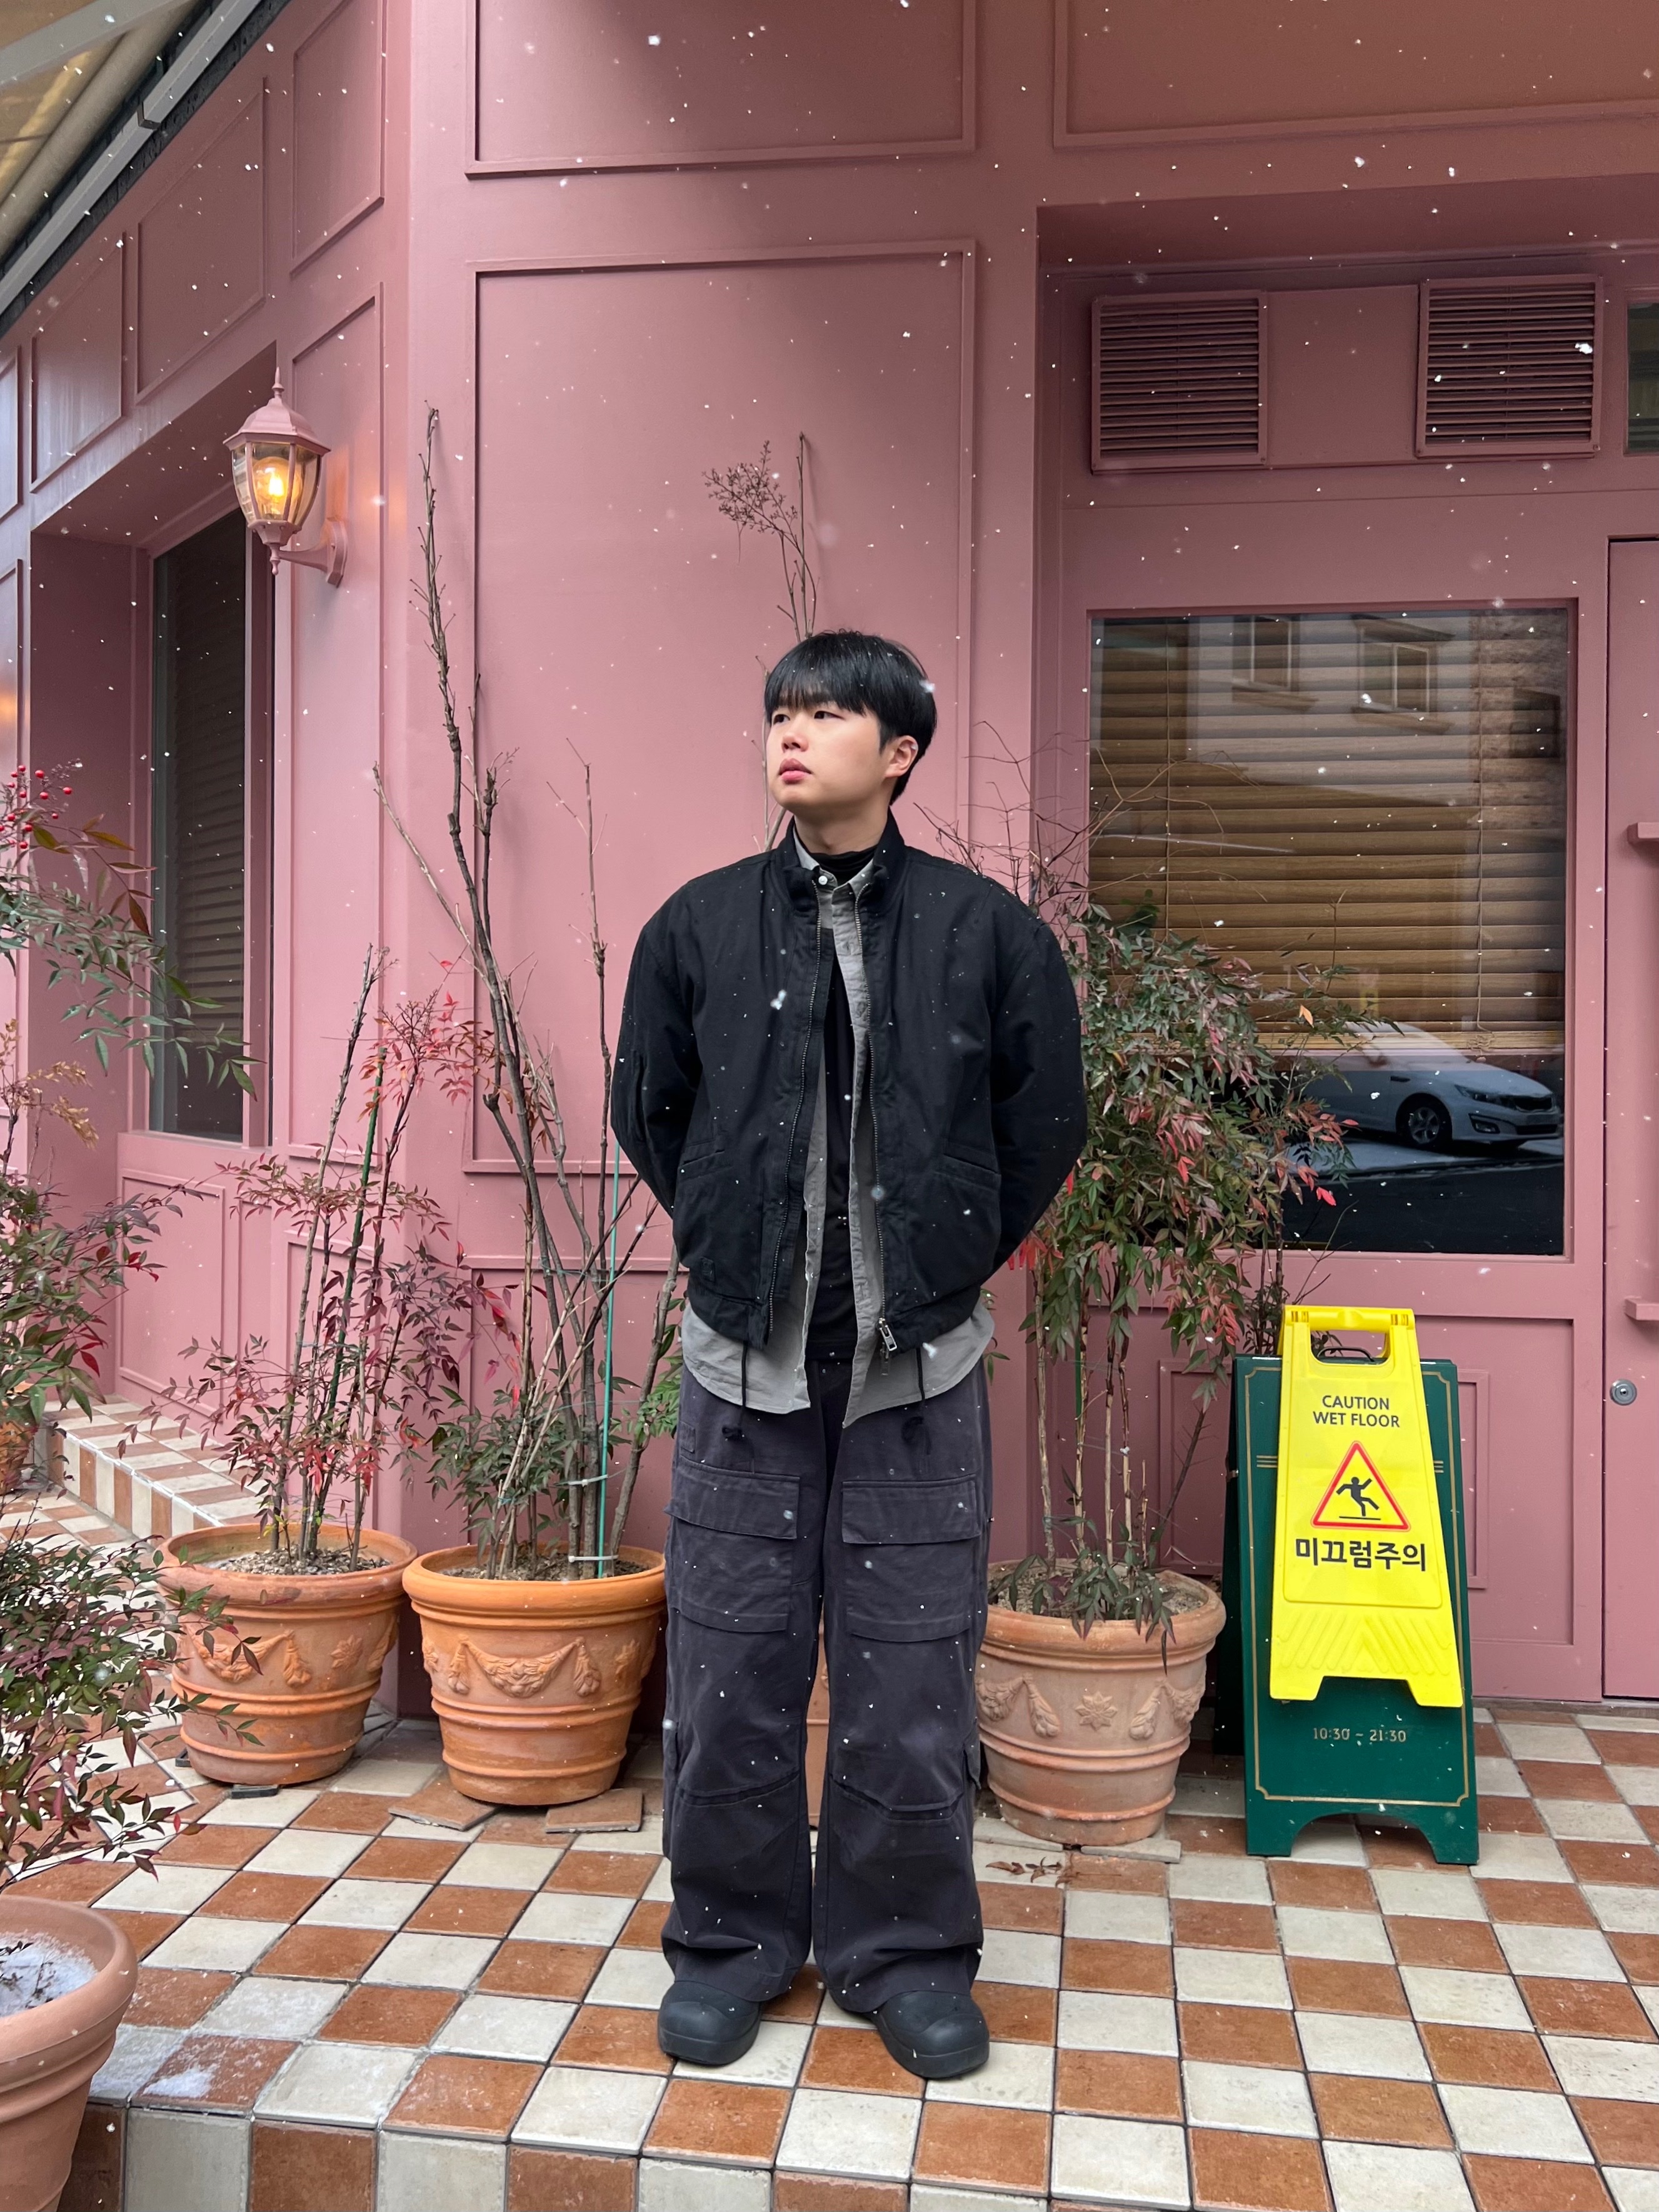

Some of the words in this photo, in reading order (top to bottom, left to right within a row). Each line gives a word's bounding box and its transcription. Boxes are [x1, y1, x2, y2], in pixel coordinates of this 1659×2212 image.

[1322, 1395, 1389, 1410] CAUTION
[1313, 1411, 1346, 1425] WET
[1351, 1413, 1400, 1428] FLOOR
[1295, 1538, 1426, 1572] 미끄럼주의
[1313, 1728, 1350, 1740] 10:30
[1370, 1729, 1406, 1743] 21:30
